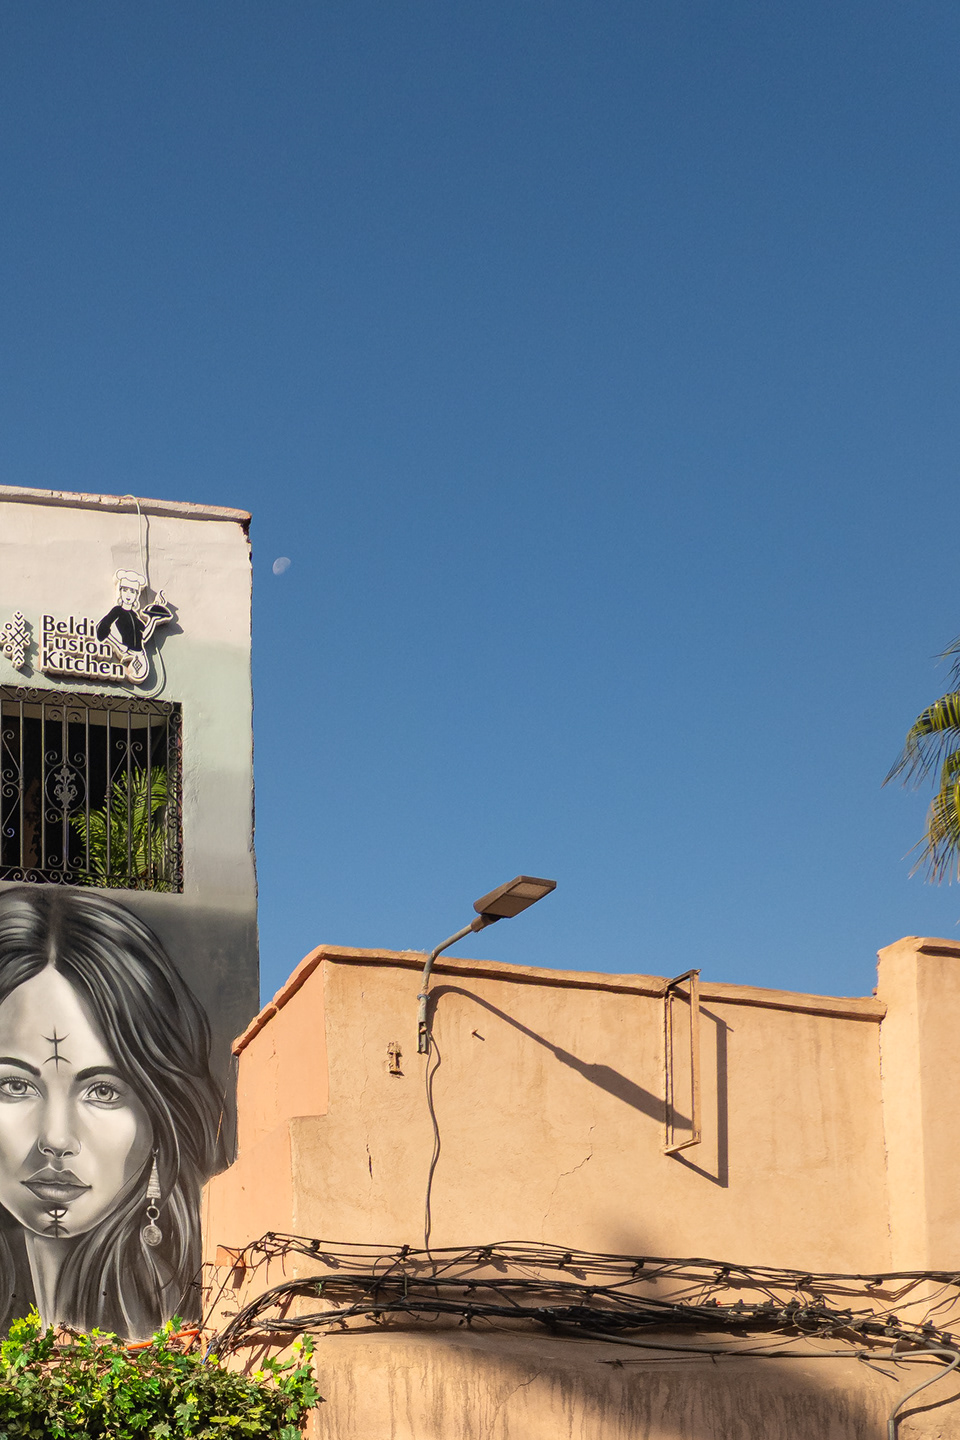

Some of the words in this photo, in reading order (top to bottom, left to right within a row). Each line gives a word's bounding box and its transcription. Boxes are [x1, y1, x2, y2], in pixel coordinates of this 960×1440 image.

[43, 615, 94, 637] Beldi
[43, 632, 112, 657] Fusion
[43, 651, 124, 677] Kitchen
